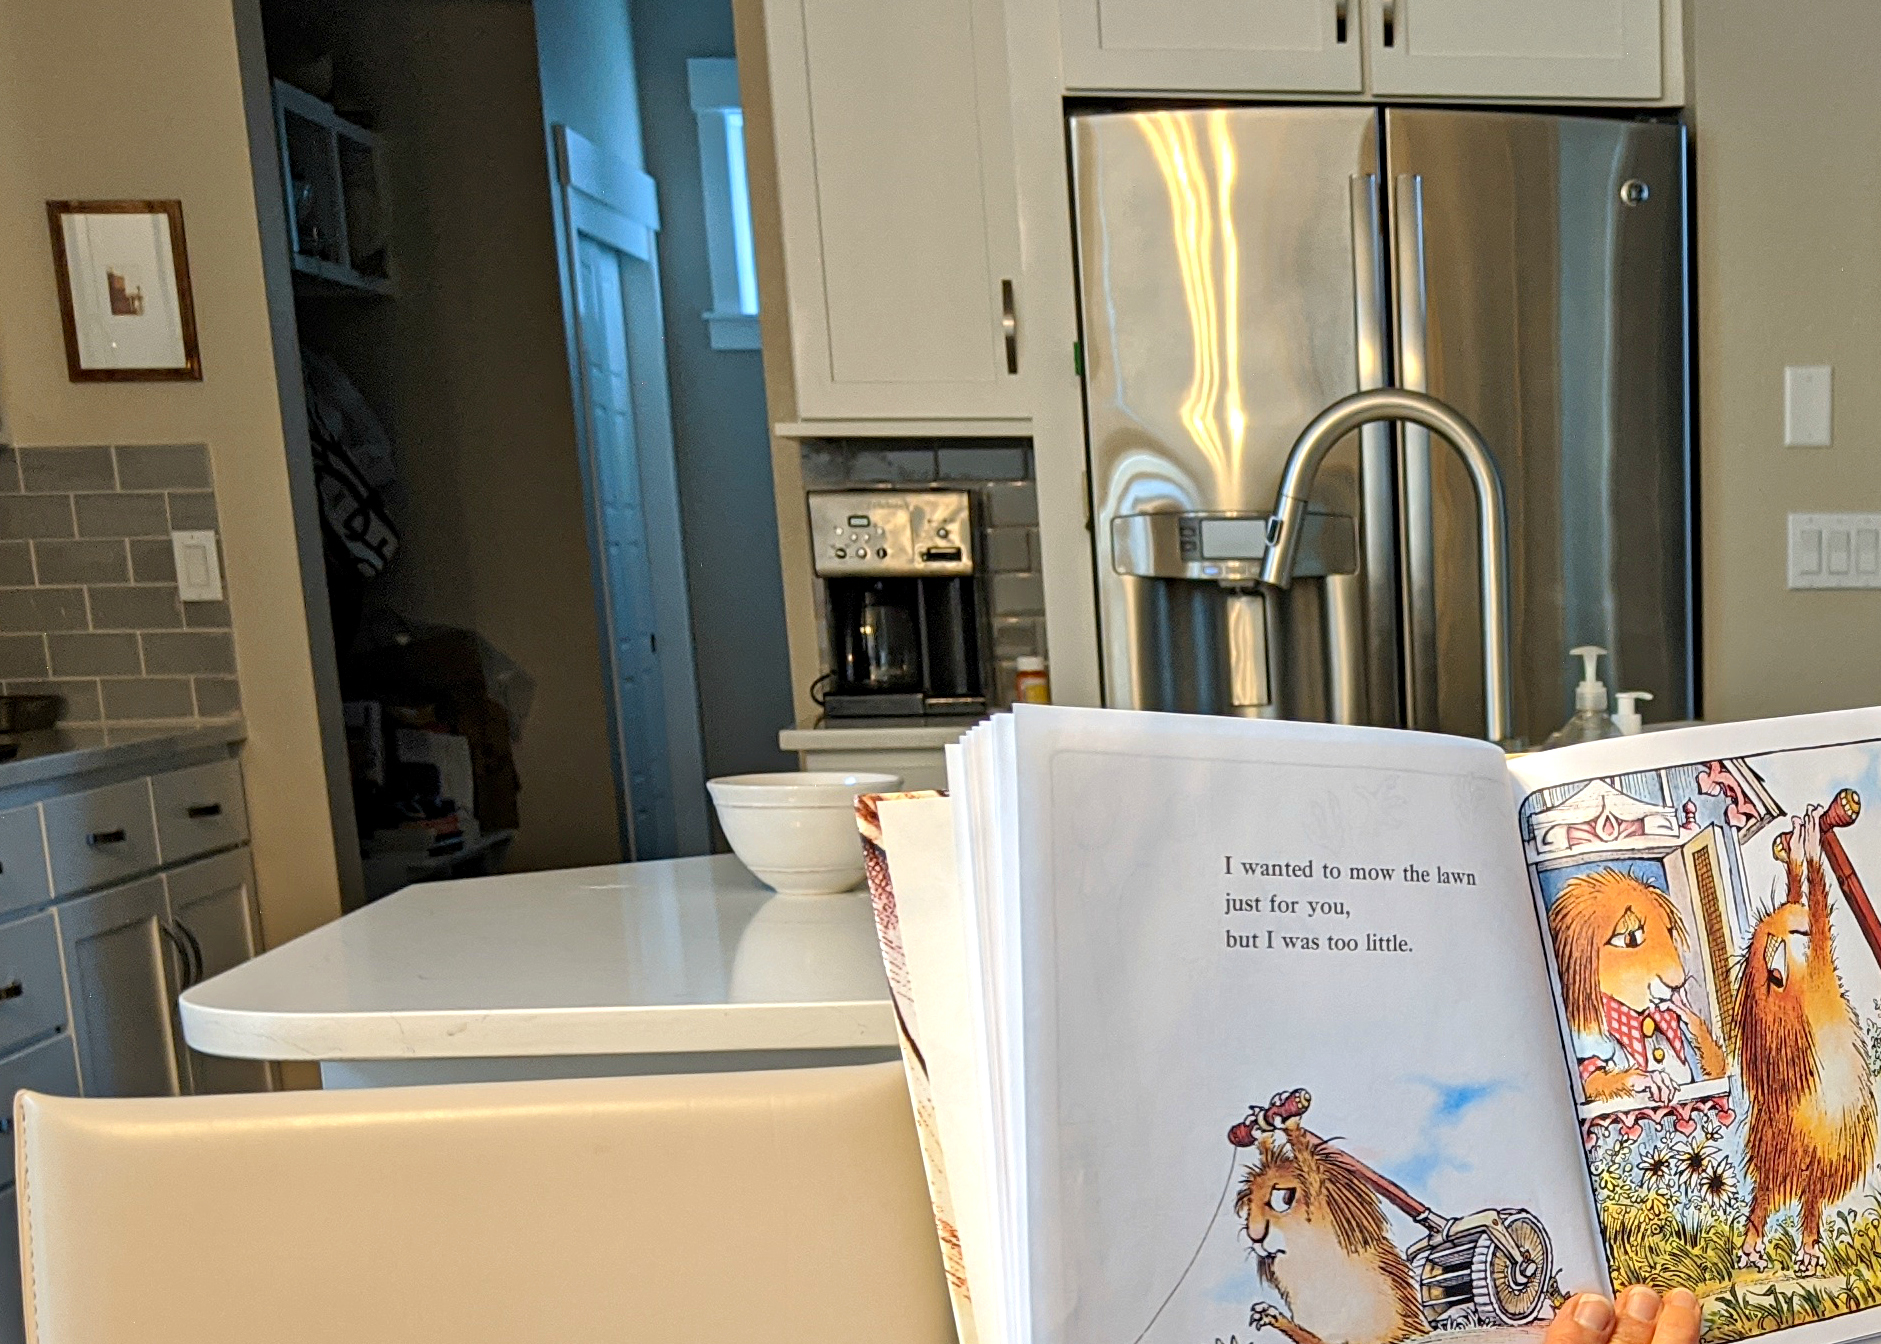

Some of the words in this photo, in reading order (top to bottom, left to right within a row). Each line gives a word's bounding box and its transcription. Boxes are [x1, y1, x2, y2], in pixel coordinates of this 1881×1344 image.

[1225, 855, 1233, 875] I
[1240, 859, 1314, 878] wanted
[1322, 863, 1341, 880] to
[1349, 867, 1395, 881] mow
[1403, 864, 1430, 883] the
[1437, 865, 1477, 886] lawn
[1224, 892, 1262, 915] just
[1269, 894, 1299, 914] for
[1307, 901, 1351, 919] you,
[1226, 929, 1259, 949] but
[1266, 930, 1274, 949] I
[1280, 936, 1320, 951] was
[1326, 935, 1359, 952] too
[1366, 933, 1413, 953] little.
